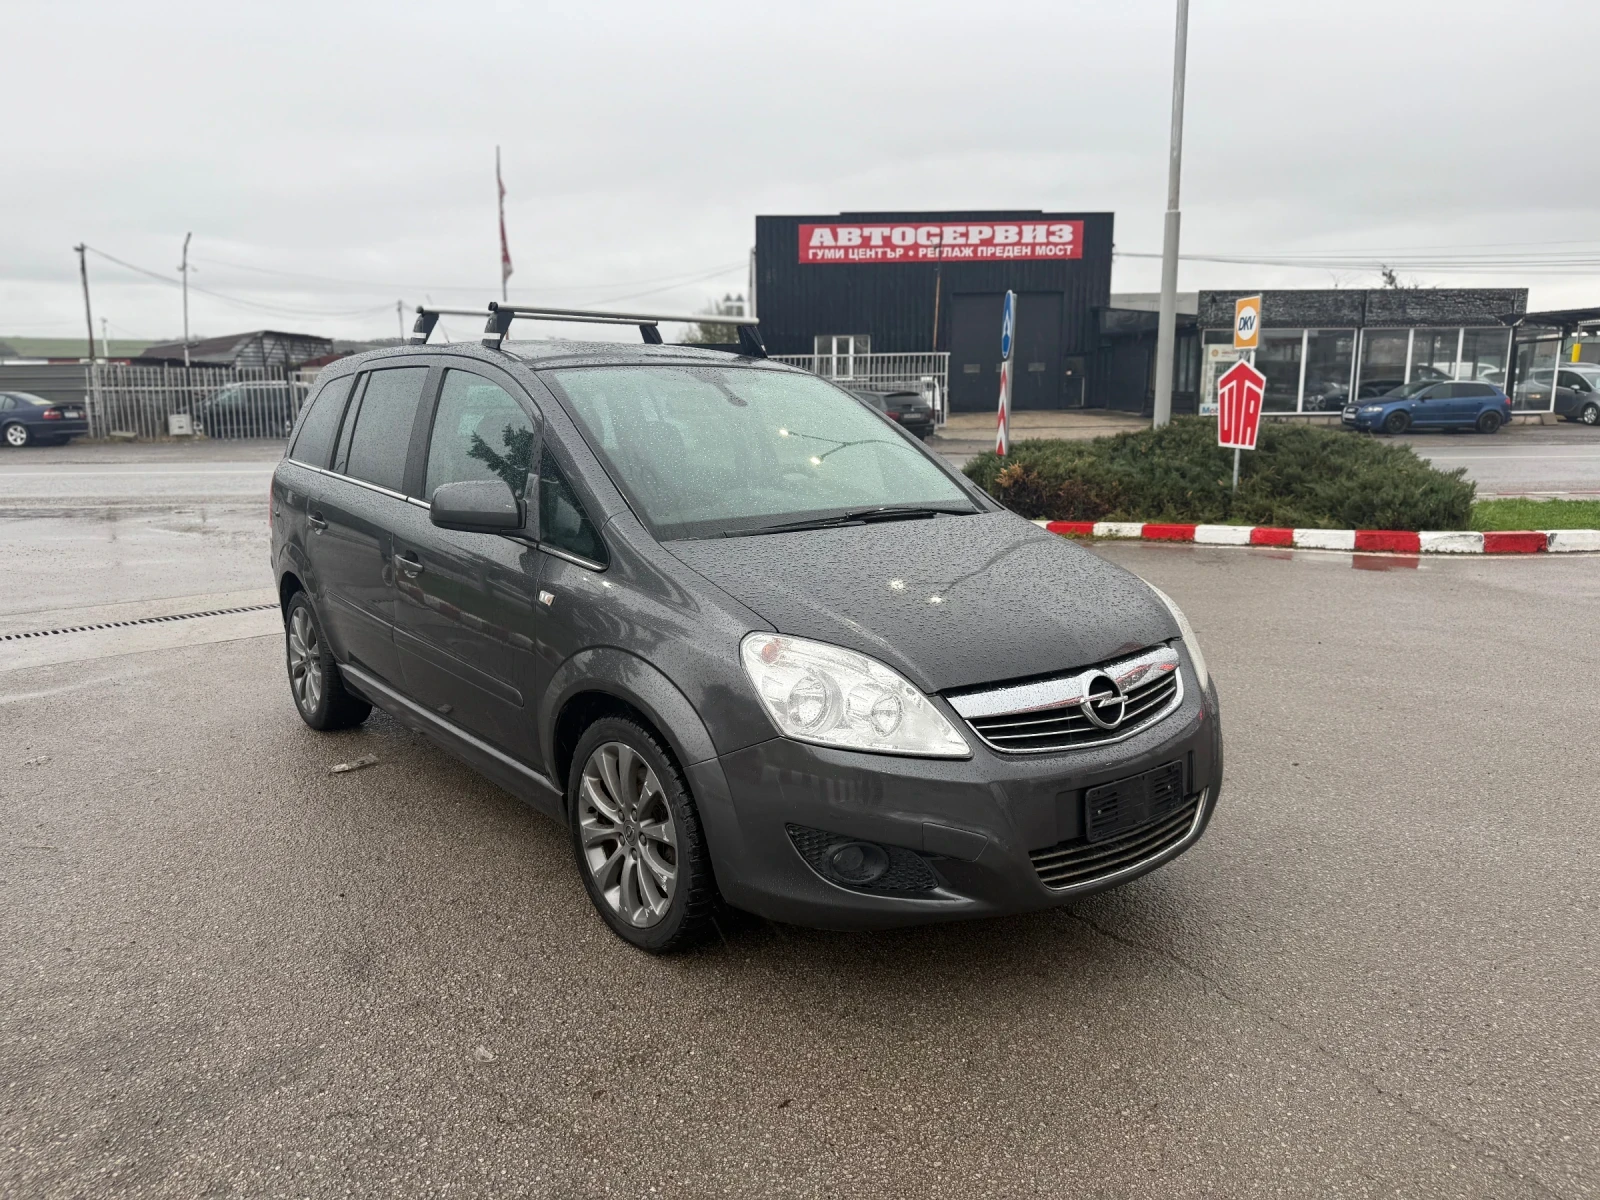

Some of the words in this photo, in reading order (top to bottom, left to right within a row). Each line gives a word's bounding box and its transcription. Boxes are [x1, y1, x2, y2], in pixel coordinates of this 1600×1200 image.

[809, 224, 1074, 247] АВТОСЕРВИЗ
[808, 248, 845, 260] ГУМИ
[848, 247, 904, 260] ЦЕНТЪР
[918, 246, 974, 259] РЕГЛАЖ
[977, 246, 1032, 259] ПРЕДЕН
[1035, 244, 1074, 256] МОСТ
[1238, 315, 1257, 332] DKV
[1219, 363, 1265, 447] UTA
